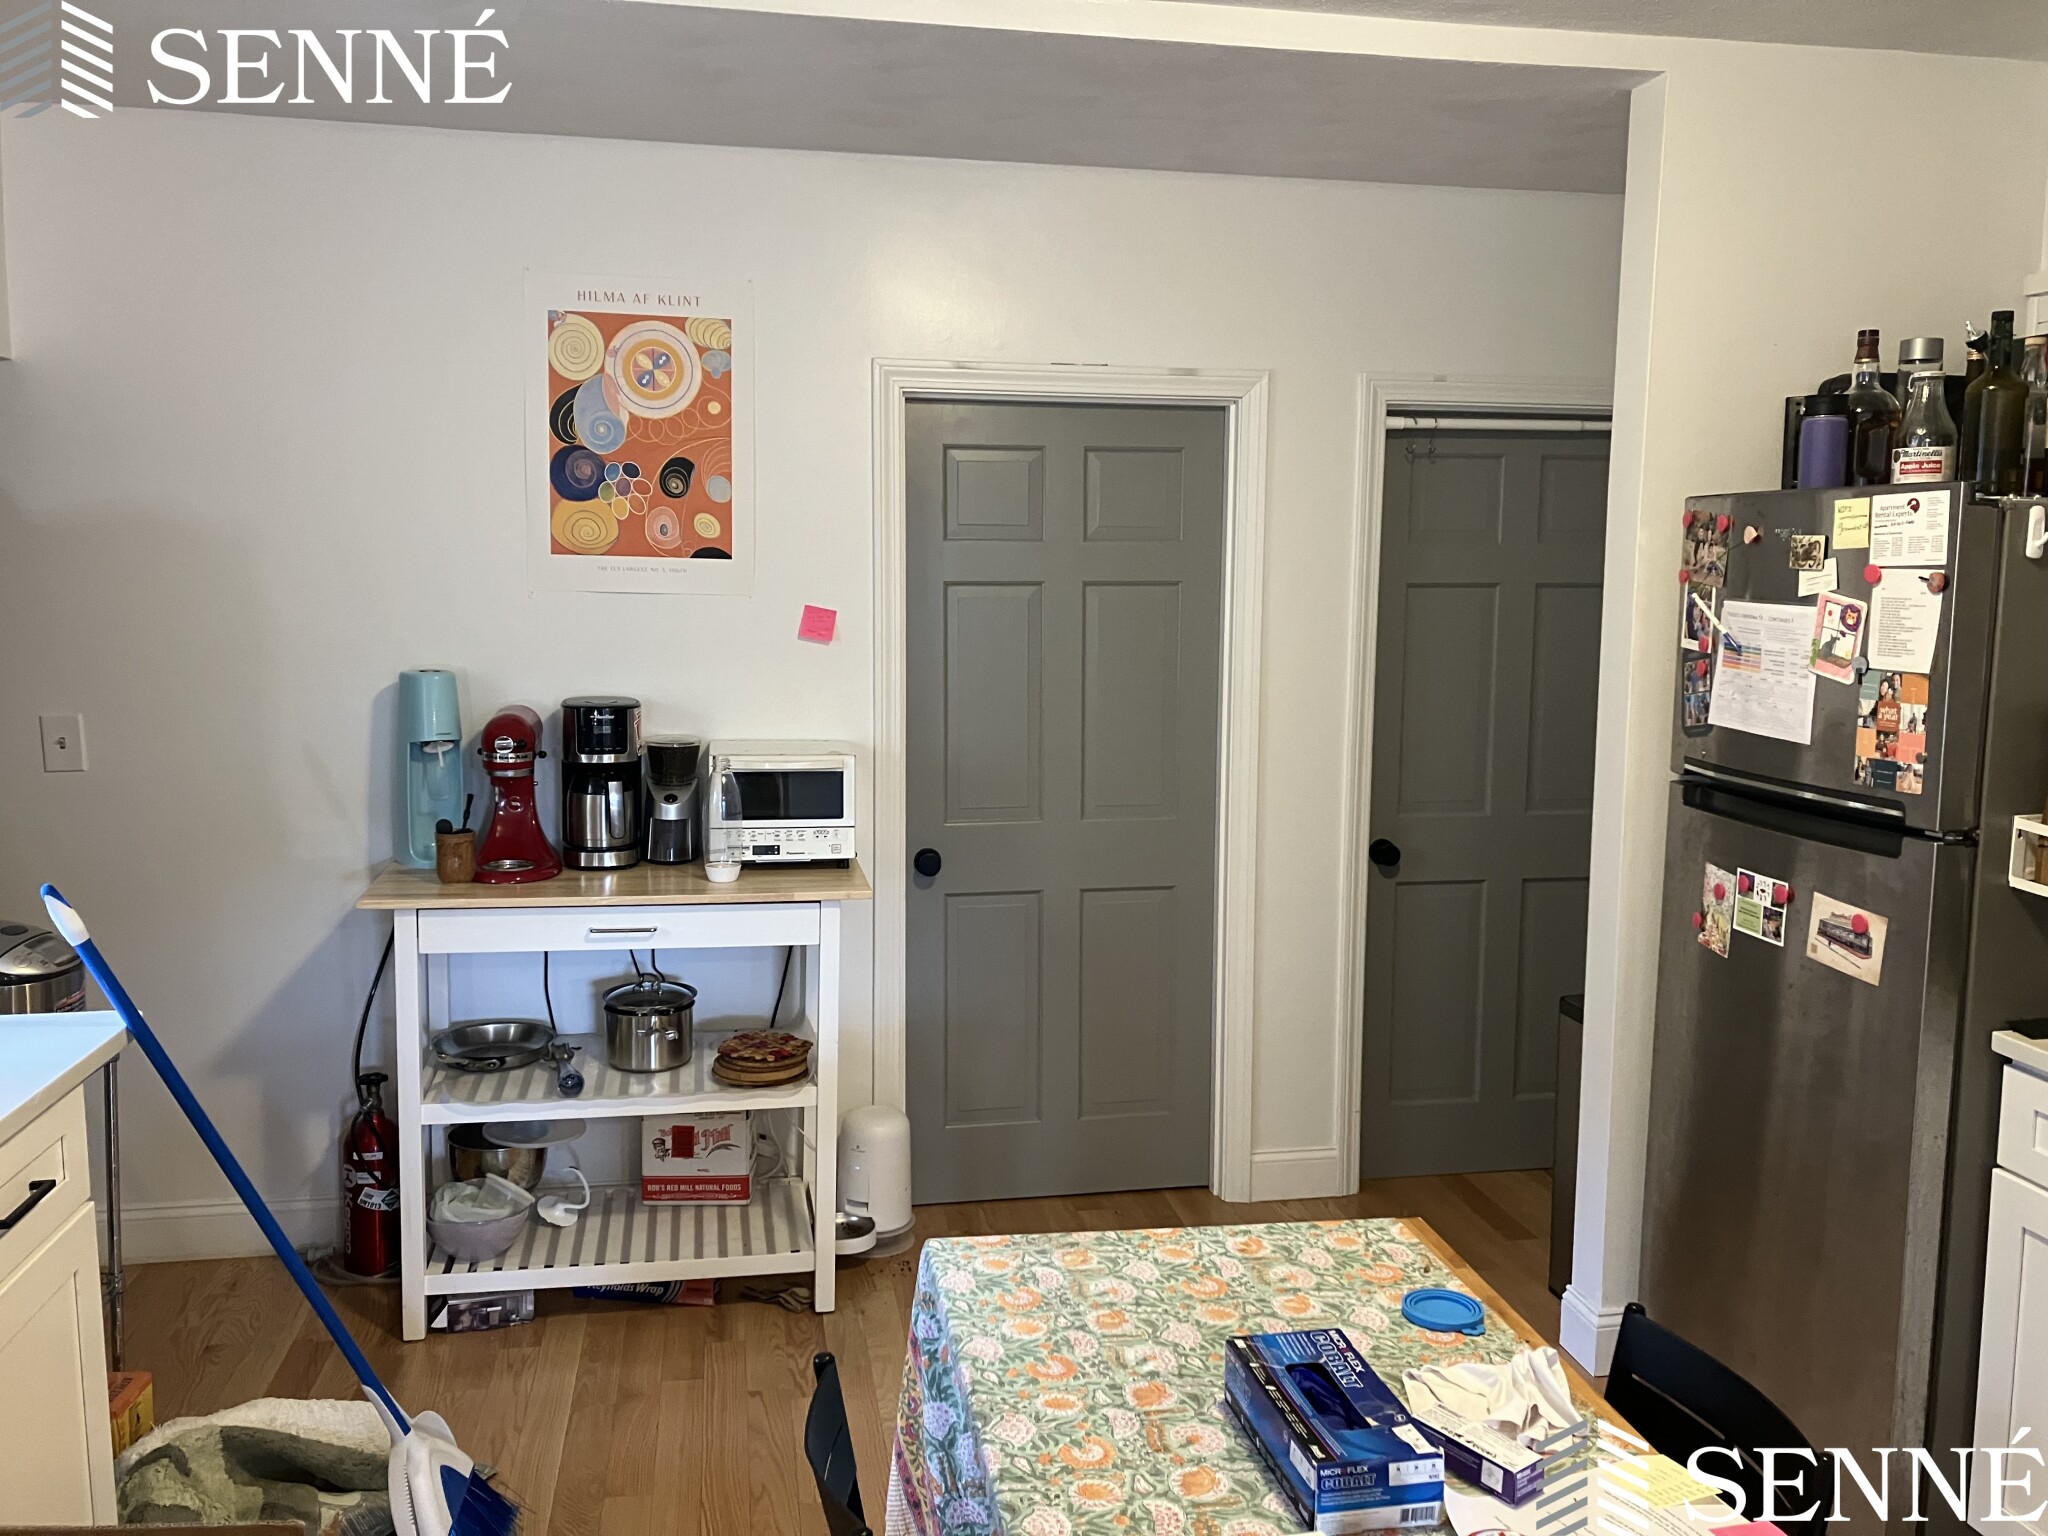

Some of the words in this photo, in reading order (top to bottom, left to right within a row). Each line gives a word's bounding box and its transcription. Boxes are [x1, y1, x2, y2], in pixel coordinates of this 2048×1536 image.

[577, 290, 626, 303] HILMA
[632, 293, 648, 304] AF
[658, 294, 702, 307] KLINT
[1921, 461, 1941, 469] Juice
[1880, 706, 1898, 714] what
[1883, 713, 1898, 721] year
[635, 1283, 664, 1296] Wrap
[1309, 1331, 1364, 1388] COBALT
